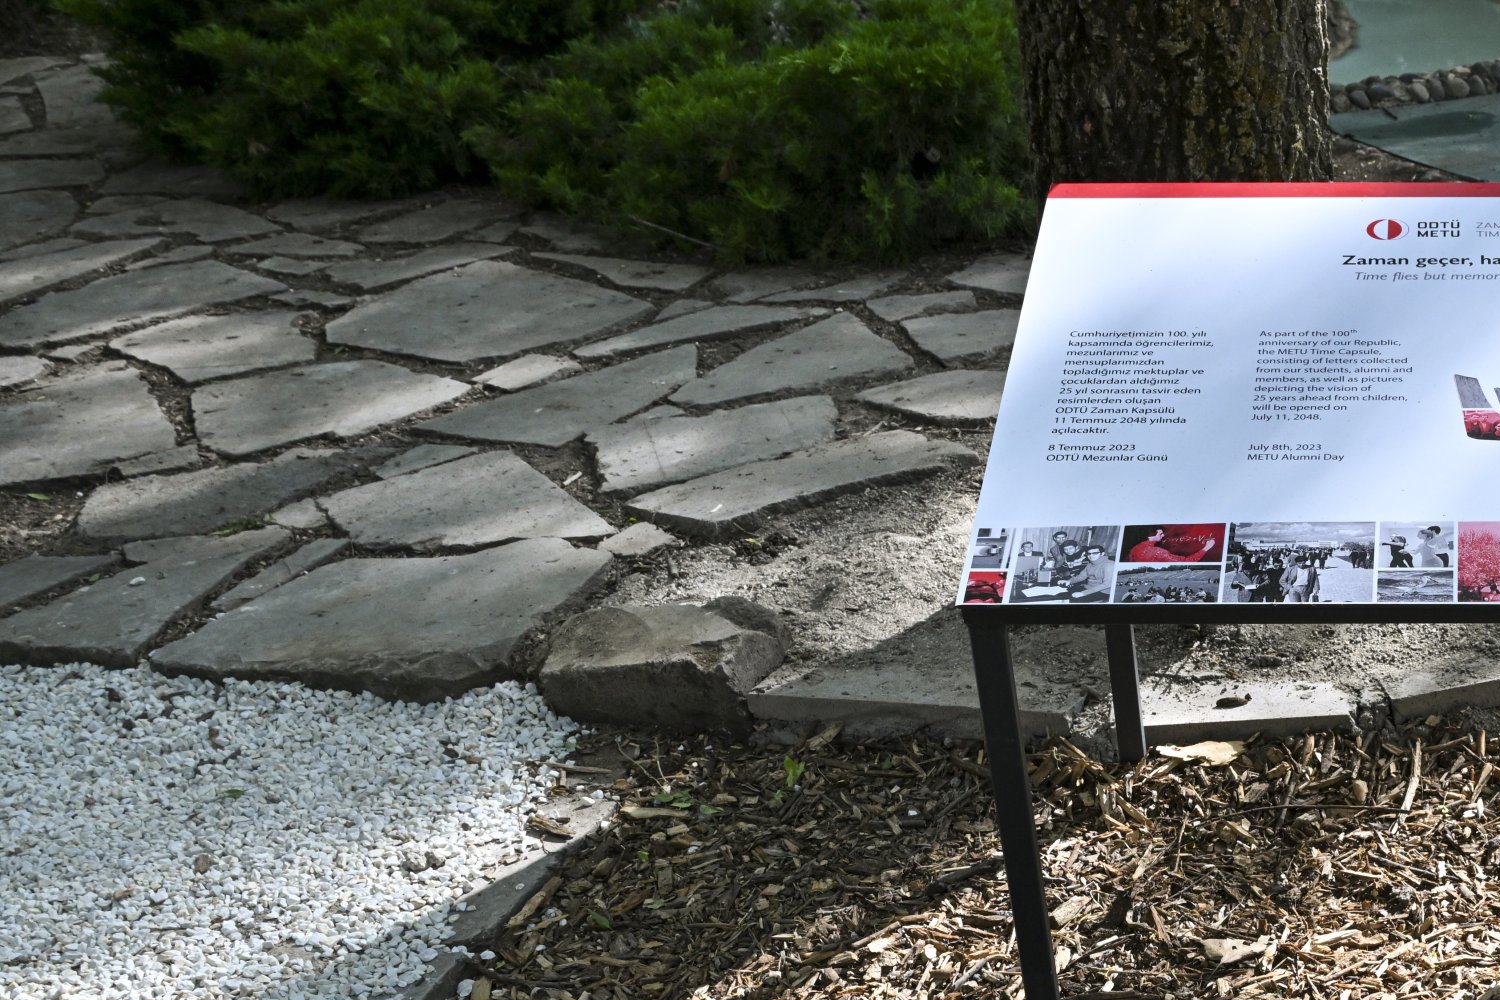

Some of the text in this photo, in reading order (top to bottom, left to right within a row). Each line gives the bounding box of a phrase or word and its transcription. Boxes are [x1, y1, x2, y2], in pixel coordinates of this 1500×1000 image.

[1417, 220, 1460, 229] ODTÜ
[1342, 255, 1409, 265] Zaman
[1416, 256, 1472, 267] geçer,
[1355, 272, 1387, 280] Time
[1393, 271, 1420, 282] flies
[1424, 271, 1446, 280] but
[1070, 331, 1164, 339] Cumhuriyetimizin
[1192, 331, 1207, 339] yılı
[1068, 340, 1213, 349] kapsamında öğrencilerimiz,
[1259, 340, 1318, 348] anniversary
[1354, 340, 1401, 348] Republic,
[1065, 359, 1164, 367] mensuplarımızdan
[1255, 376, 1307, 384] members,
[1362, 376, 1403, 384] pictures
[1254, 385, 1304, 393] depicting
[1125, 398, 1161, 406] oluşan
[1132, 407, 1175, 415] Kapsülü
[1290, 404, 1330, 412] opened
[1149, 417, 1186, 425] yılında
[1251, 414, 1272, 422] July
[1052, 427, 1109, 435] açılacaktır.
[1248, 444, 1269, 452] July
[1272, 444, 1292, 452] 8th,
[1047, 453, 1079, 461] ODTÜ
[1324, 454, 1344, 462] Day
